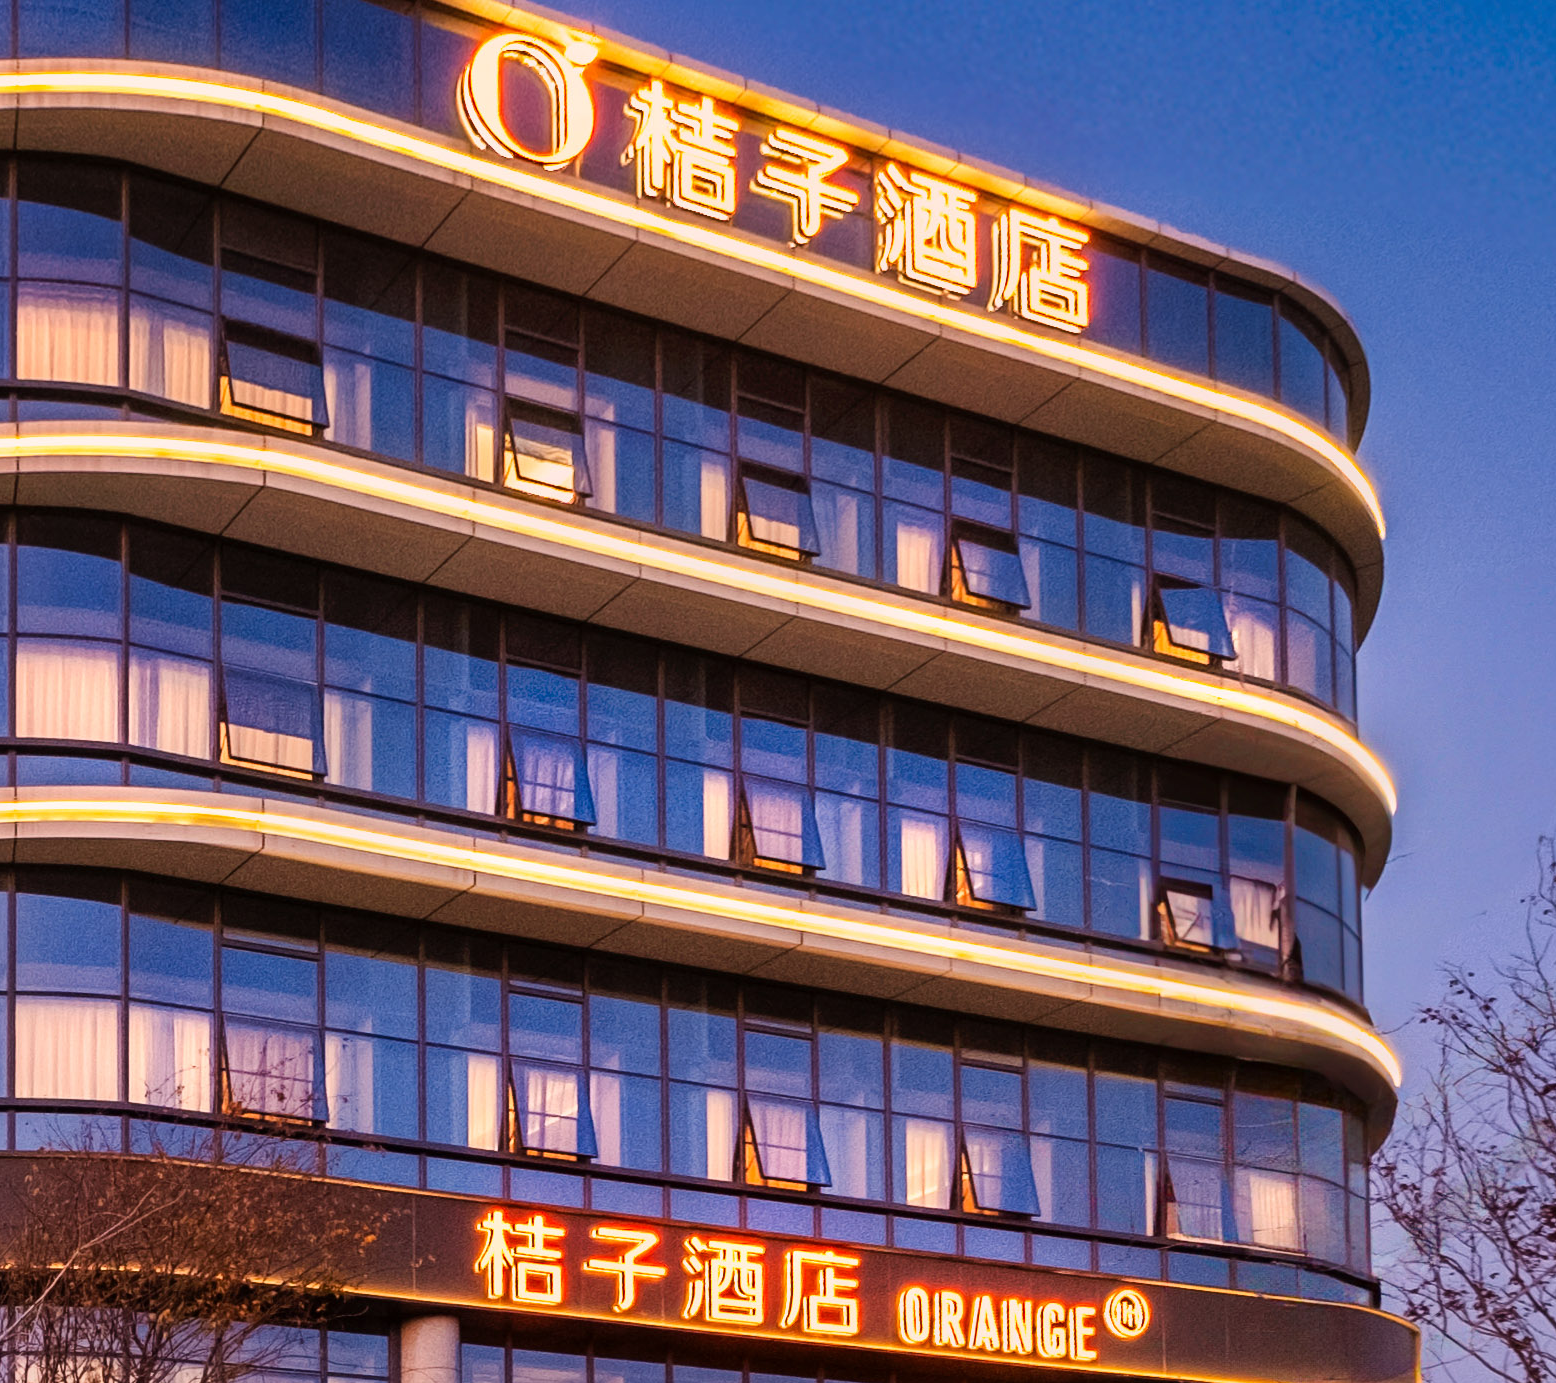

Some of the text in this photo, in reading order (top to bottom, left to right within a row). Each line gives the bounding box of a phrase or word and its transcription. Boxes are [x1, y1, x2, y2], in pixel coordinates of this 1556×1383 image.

[620, 79, 1090, 334] 桔子酒店
[474, 1211, 862, 1337] 桔子酒店
[899, 1285, 1098, 1361] ORANGE
